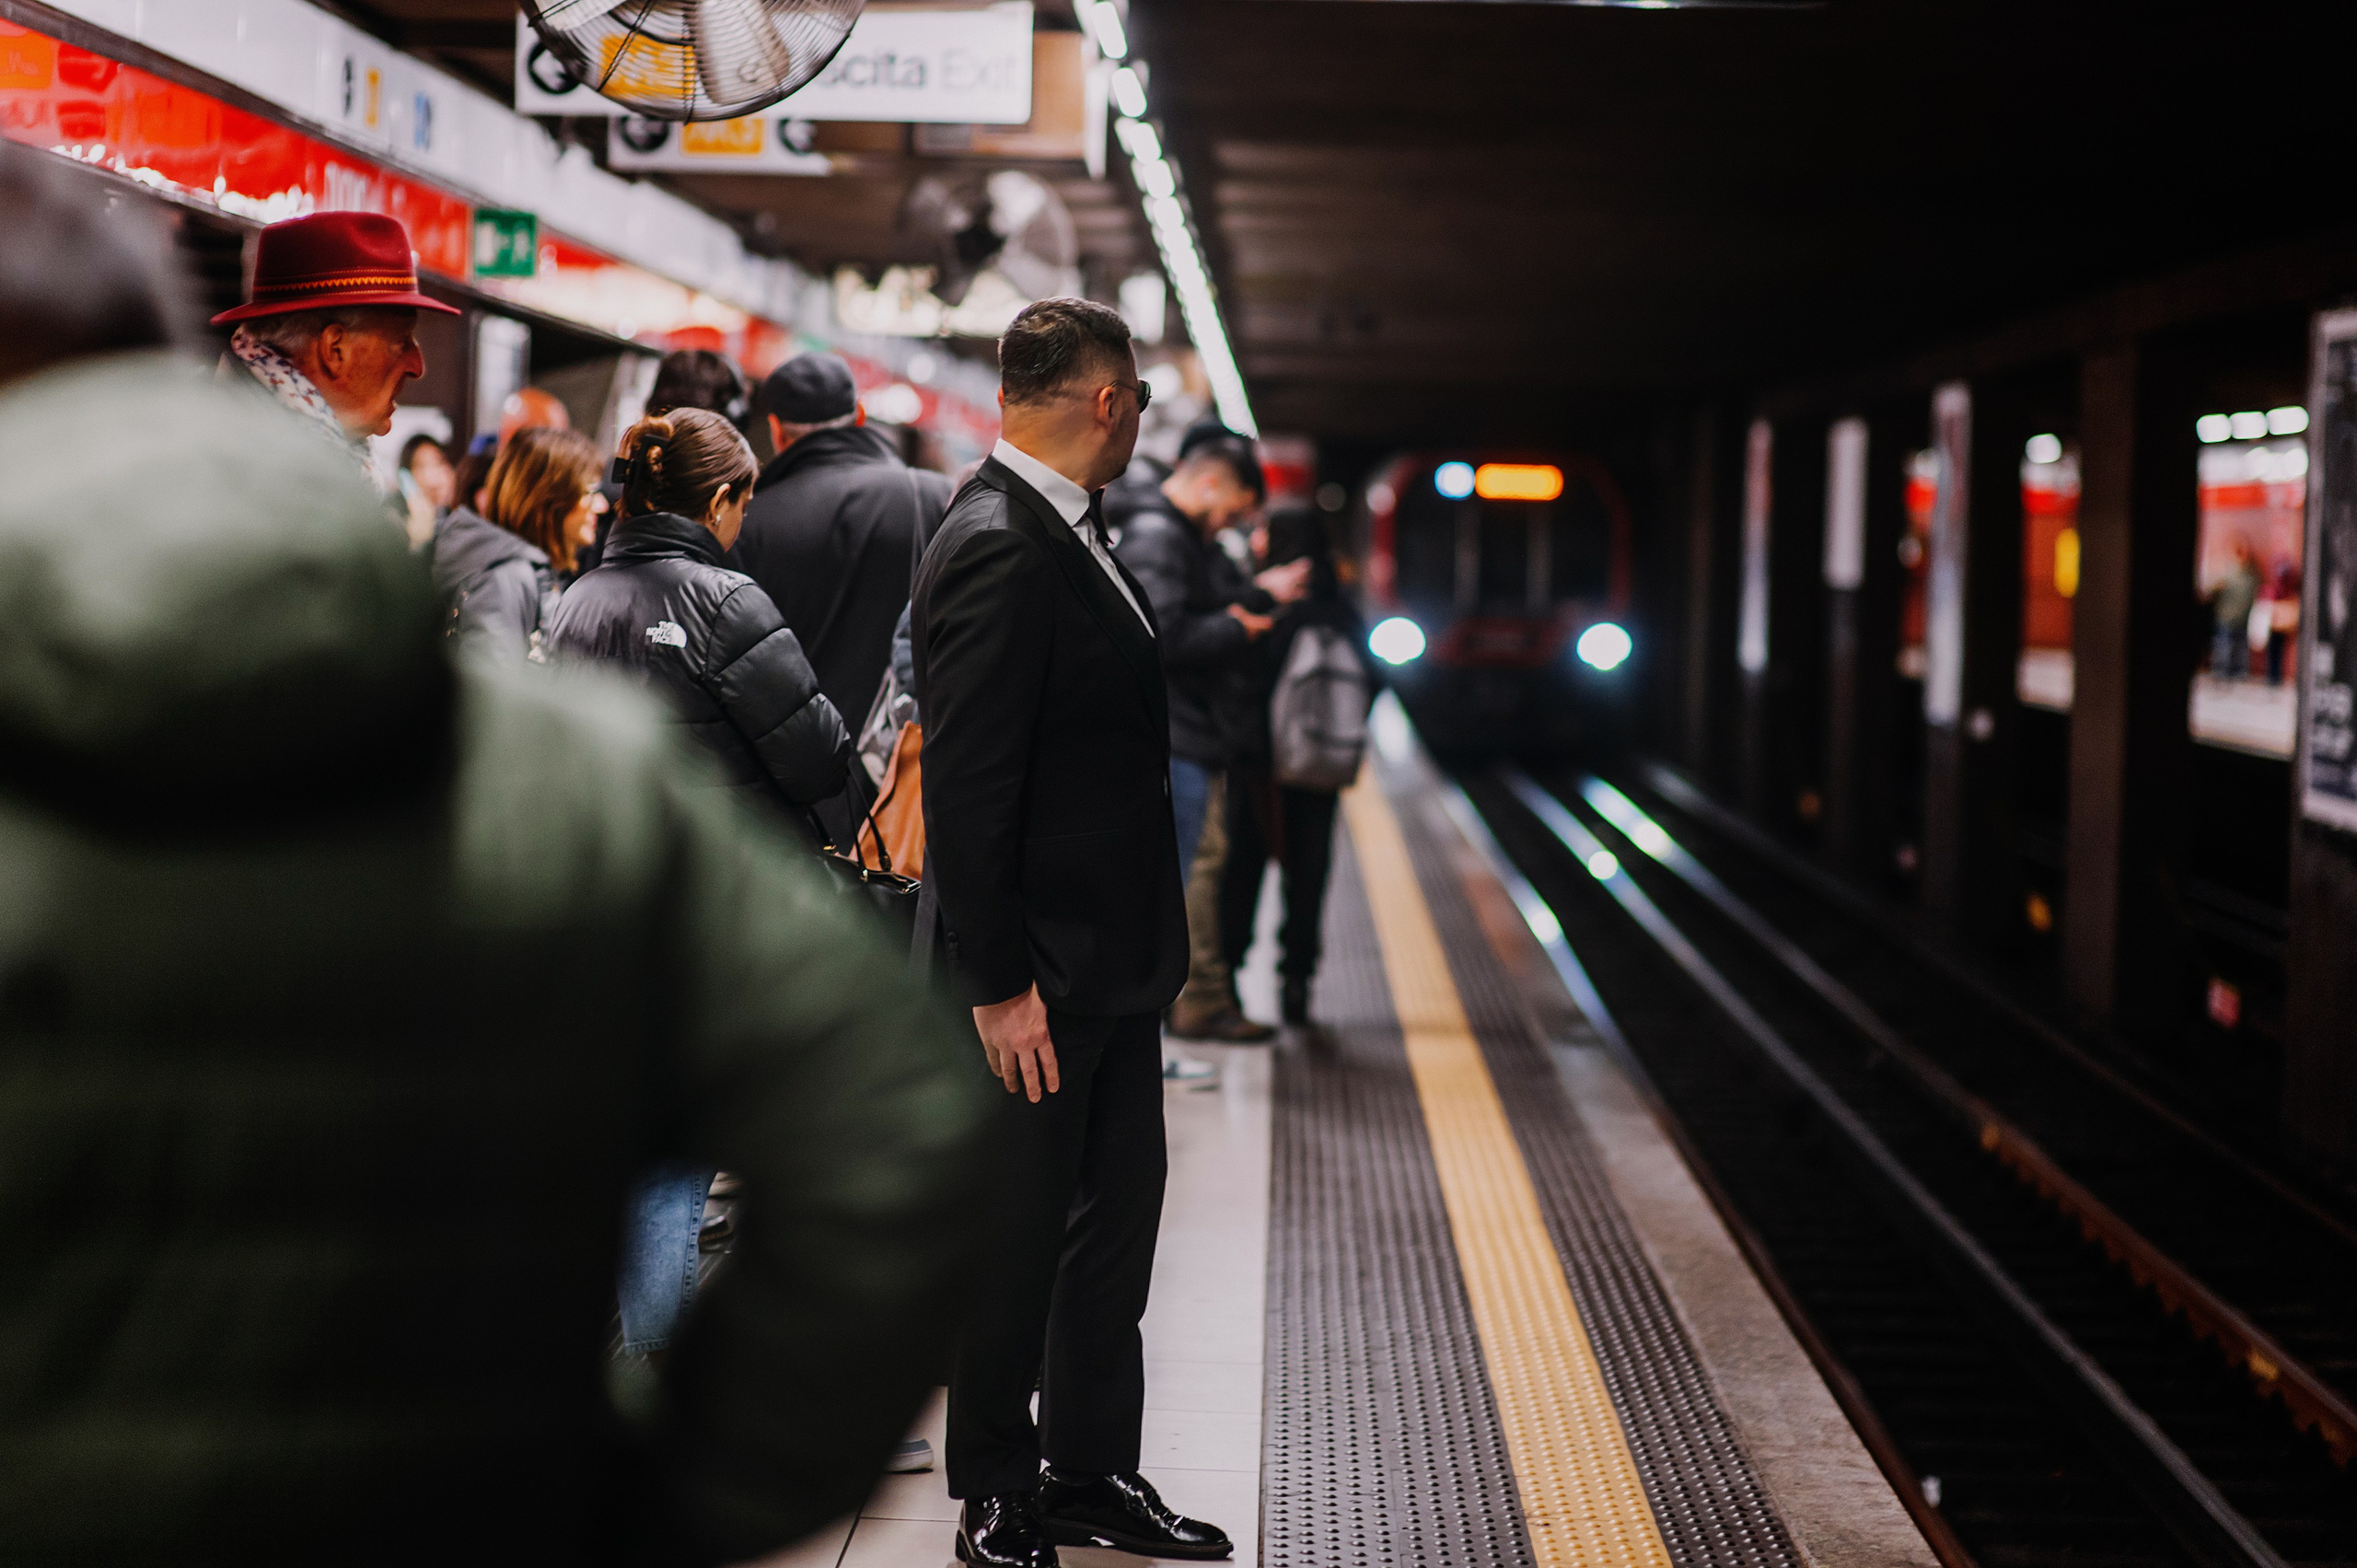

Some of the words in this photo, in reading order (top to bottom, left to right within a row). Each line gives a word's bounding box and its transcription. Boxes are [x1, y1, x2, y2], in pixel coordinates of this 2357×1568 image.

[657, 621, 675, 630] THE
[645, 627, 672, 637] NORTH
[652, 635, 672, 645] FACE
